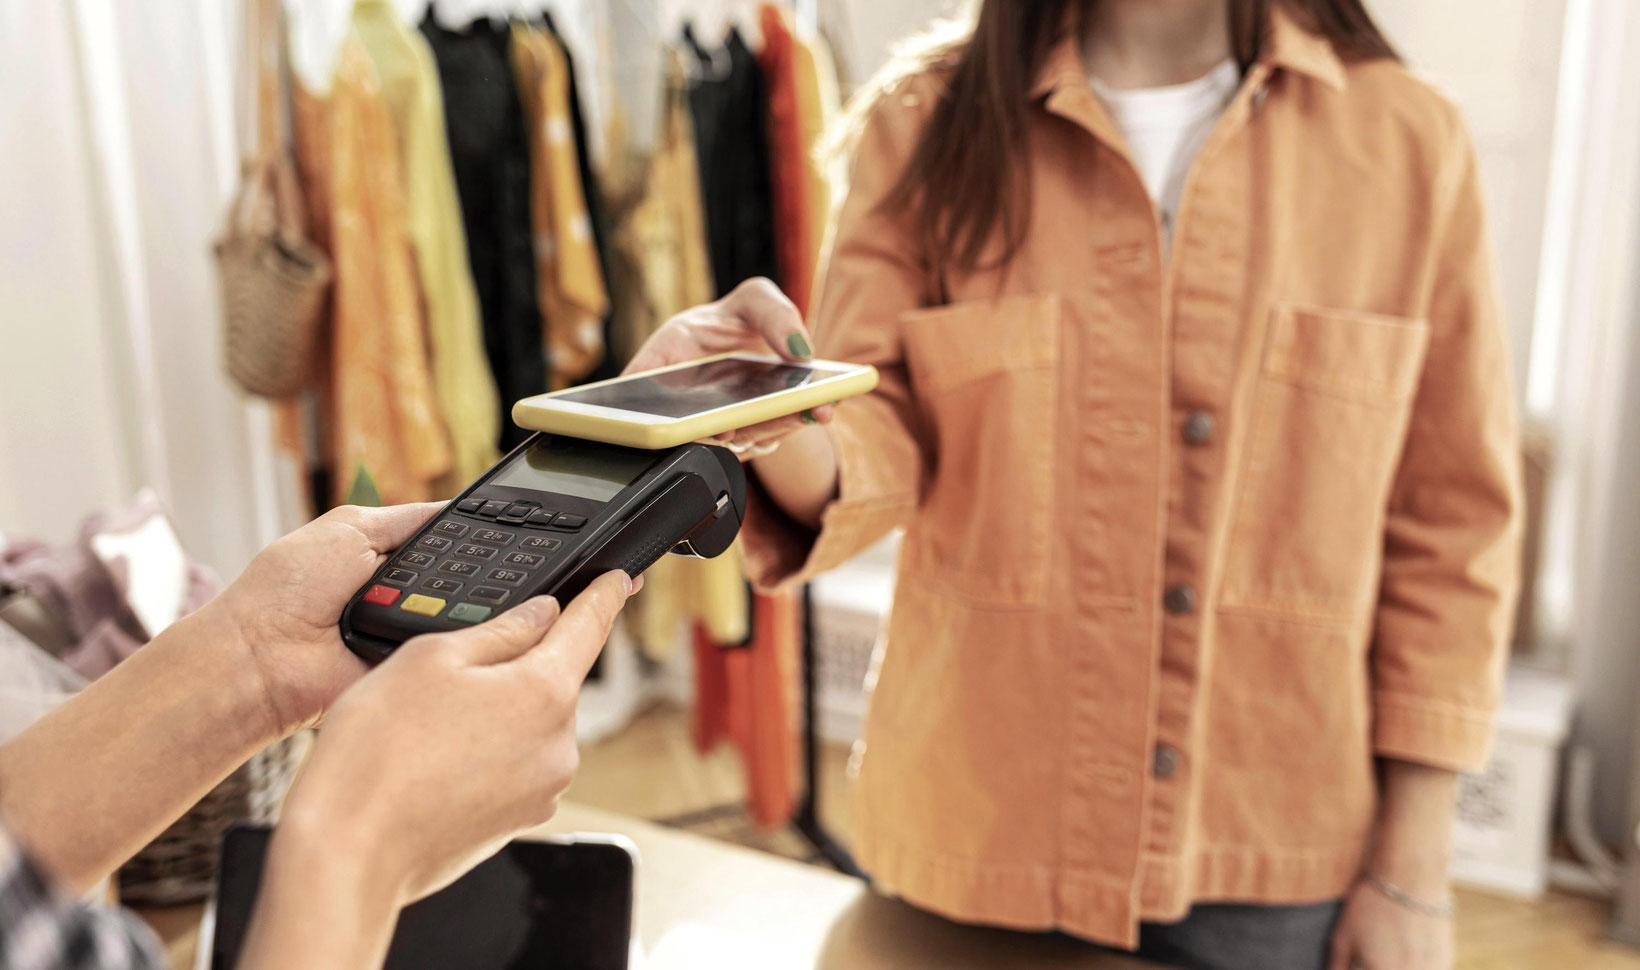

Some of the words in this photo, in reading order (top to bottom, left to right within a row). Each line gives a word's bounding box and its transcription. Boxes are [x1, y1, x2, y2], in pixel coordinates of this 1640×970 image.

[483, 531, 494, 539] 2
[531, 538, 542, 546] 3
[466, 546, 477, 554] 5
[408, 553, 419, 561] 7
[513, 554, 524, 562] 6
[450, 563, 461, 571] 8
[389, 570, 400, 578] F
[495, 571, 507, 579] 9
